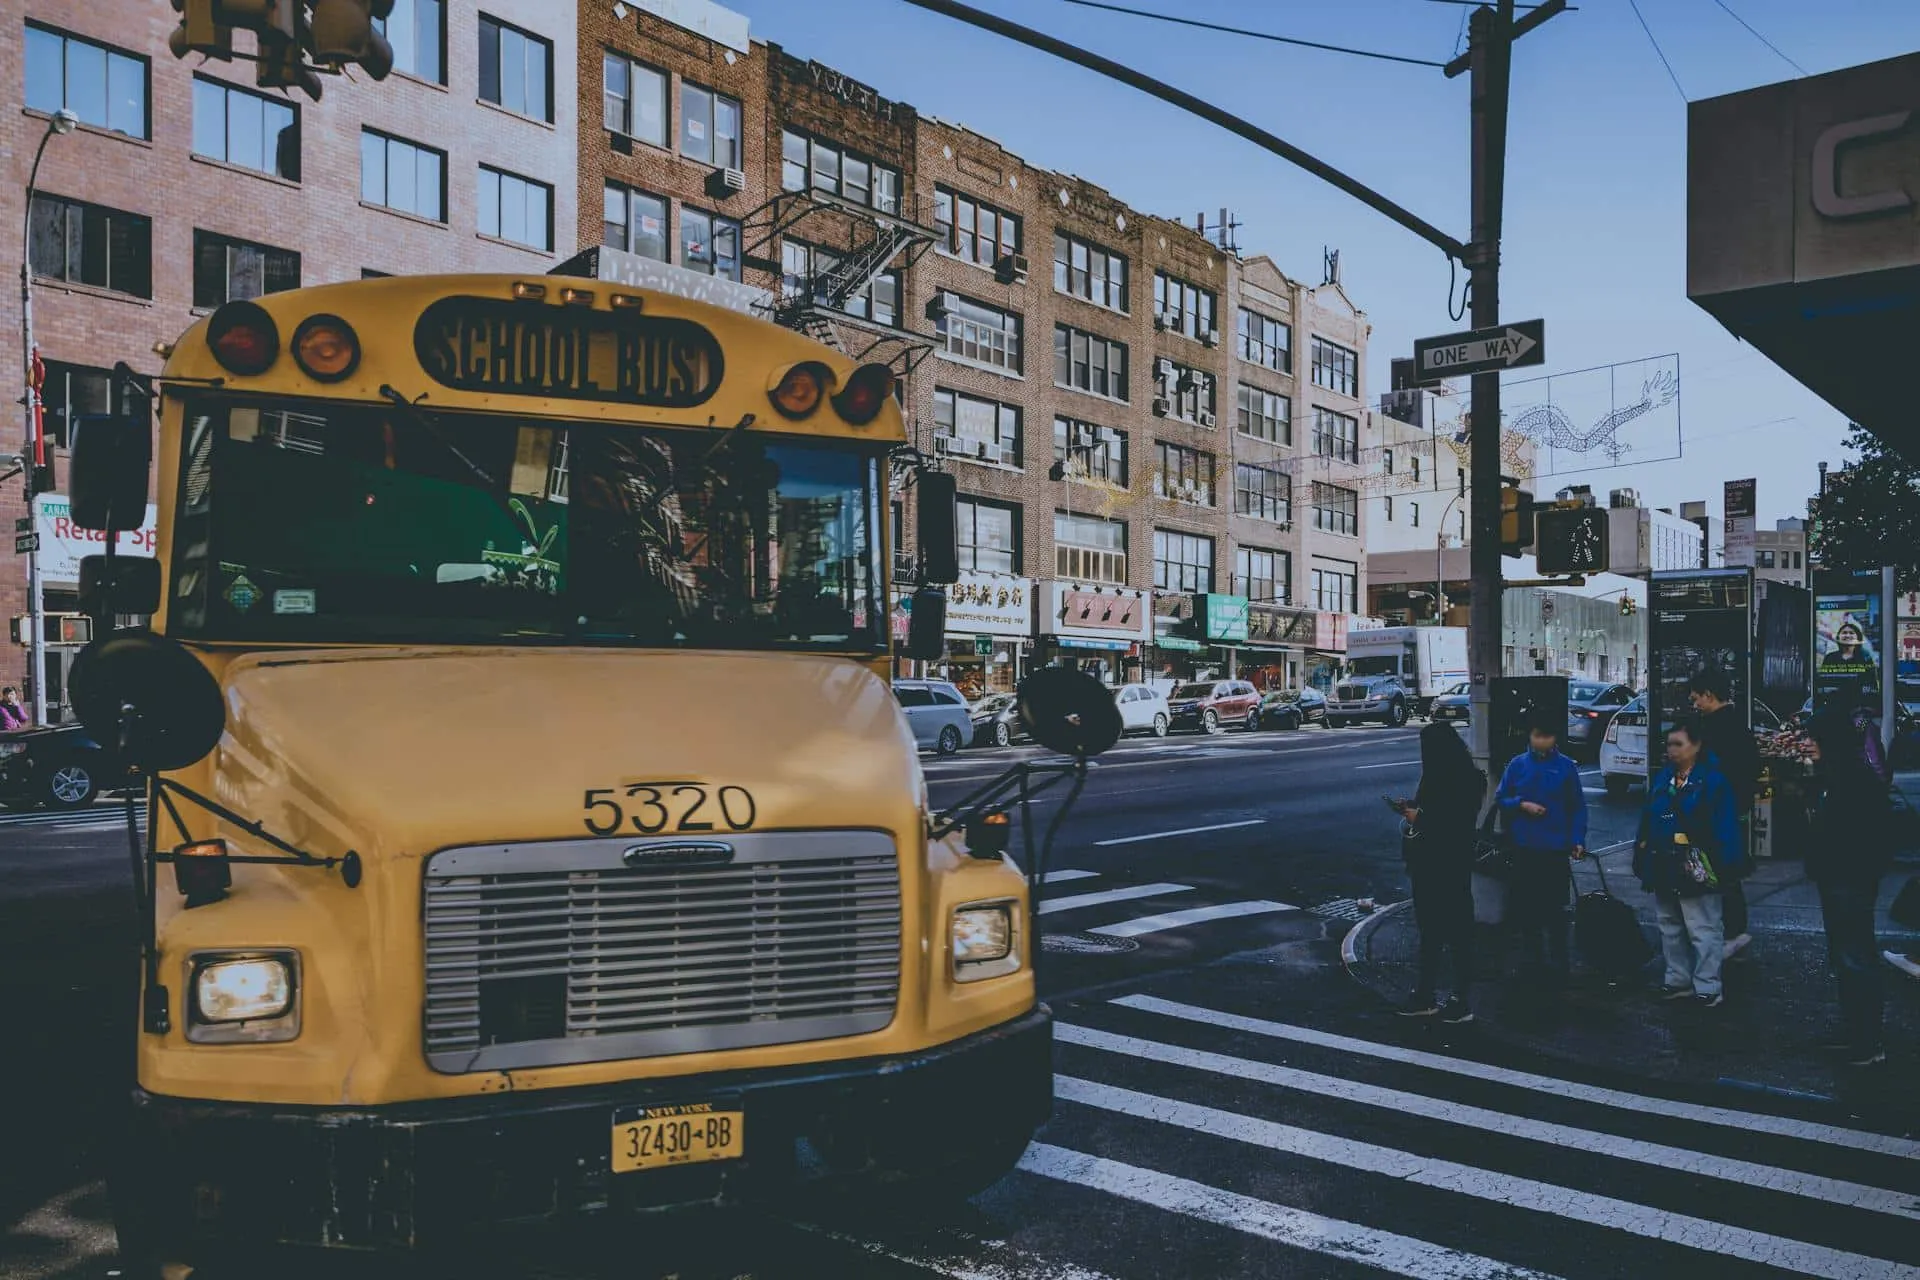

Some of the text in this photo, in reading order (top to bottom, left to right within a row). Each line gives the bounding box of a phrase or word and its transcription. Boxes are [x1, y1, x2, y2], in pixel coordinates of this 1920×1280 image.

[1812, 110, 1912, 217] C
[432, 318, 699, 401] SCHOOL BUS
[1432, 337, 1524, 367] ONE WAY
[584, 785, 757, 837] 5320
[626, 1116, 732, 1159] 32430 BB
